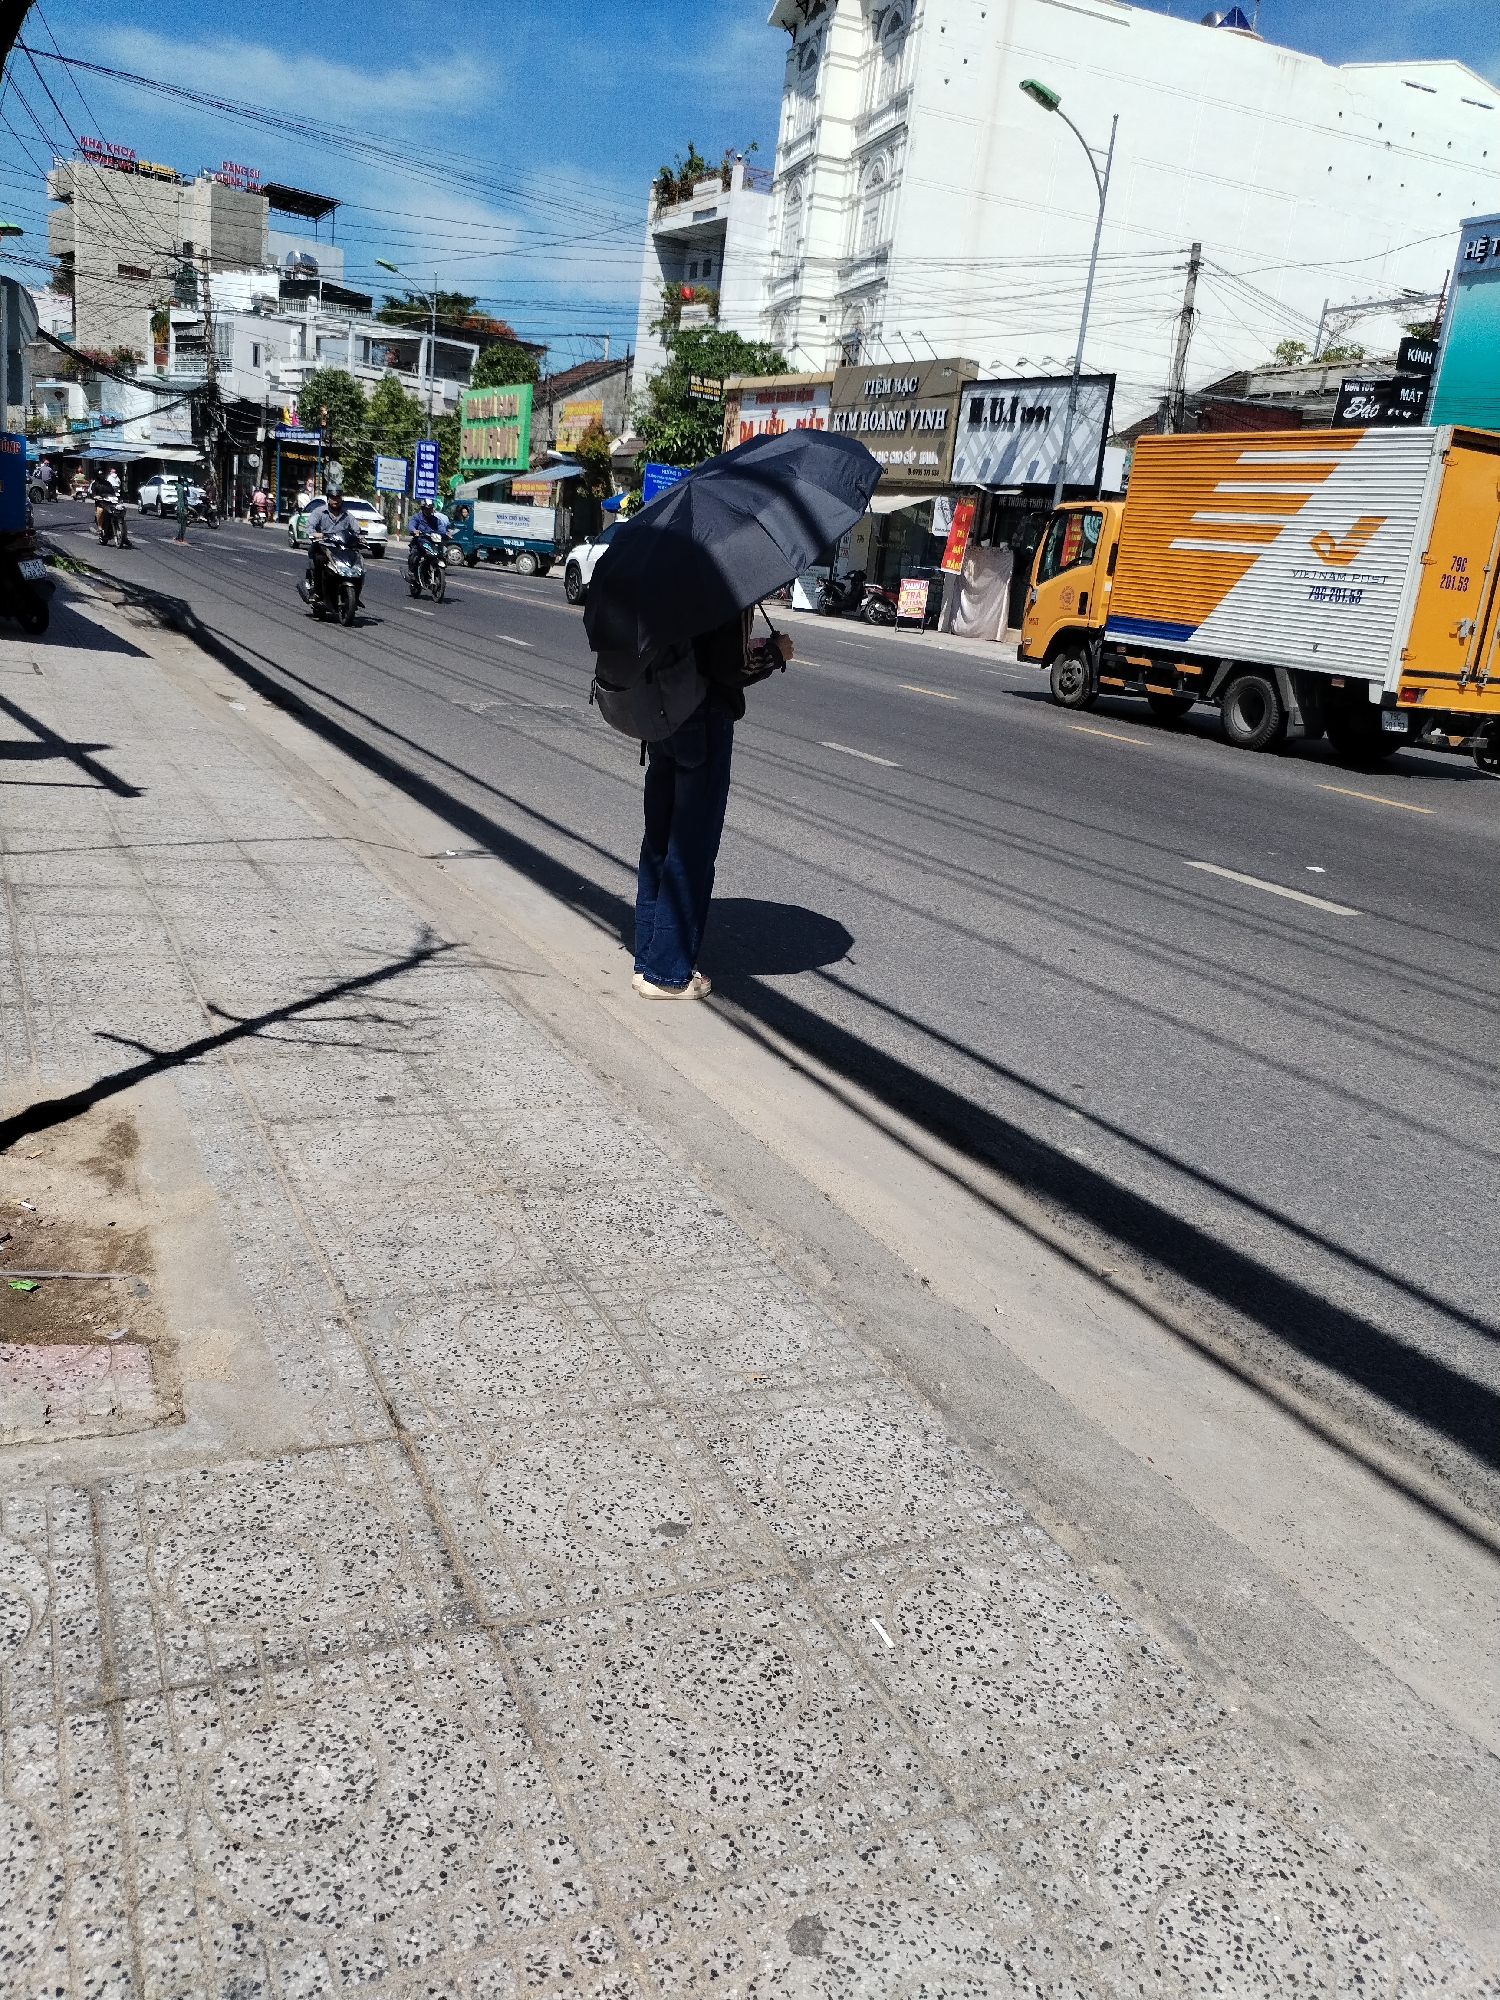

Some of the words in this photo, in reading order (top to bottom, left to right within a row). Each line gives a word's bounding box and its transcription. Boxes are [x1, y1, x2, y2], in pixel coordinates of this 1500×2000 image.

[105, 142, 136, 159] KHOA
[1464, 235, 1488, 262] HỆ
[1408, 347, 1432, 364] KÍNH
[864, 374, 892, 398] TIỆM
[894, 377, 918, 396] BẠC
[833, 411, 859, 431] KIM
[860, 403, 907, 431] HOÀNG
[910, 409, 947, 430] VINH
[1450, 555, 1468, 573] 79C
[1292, 569, 1347, 581] VIETNAM
[1351, 573, 1389, 584] POST
[1439, 573, 1470, 592] 201.53
